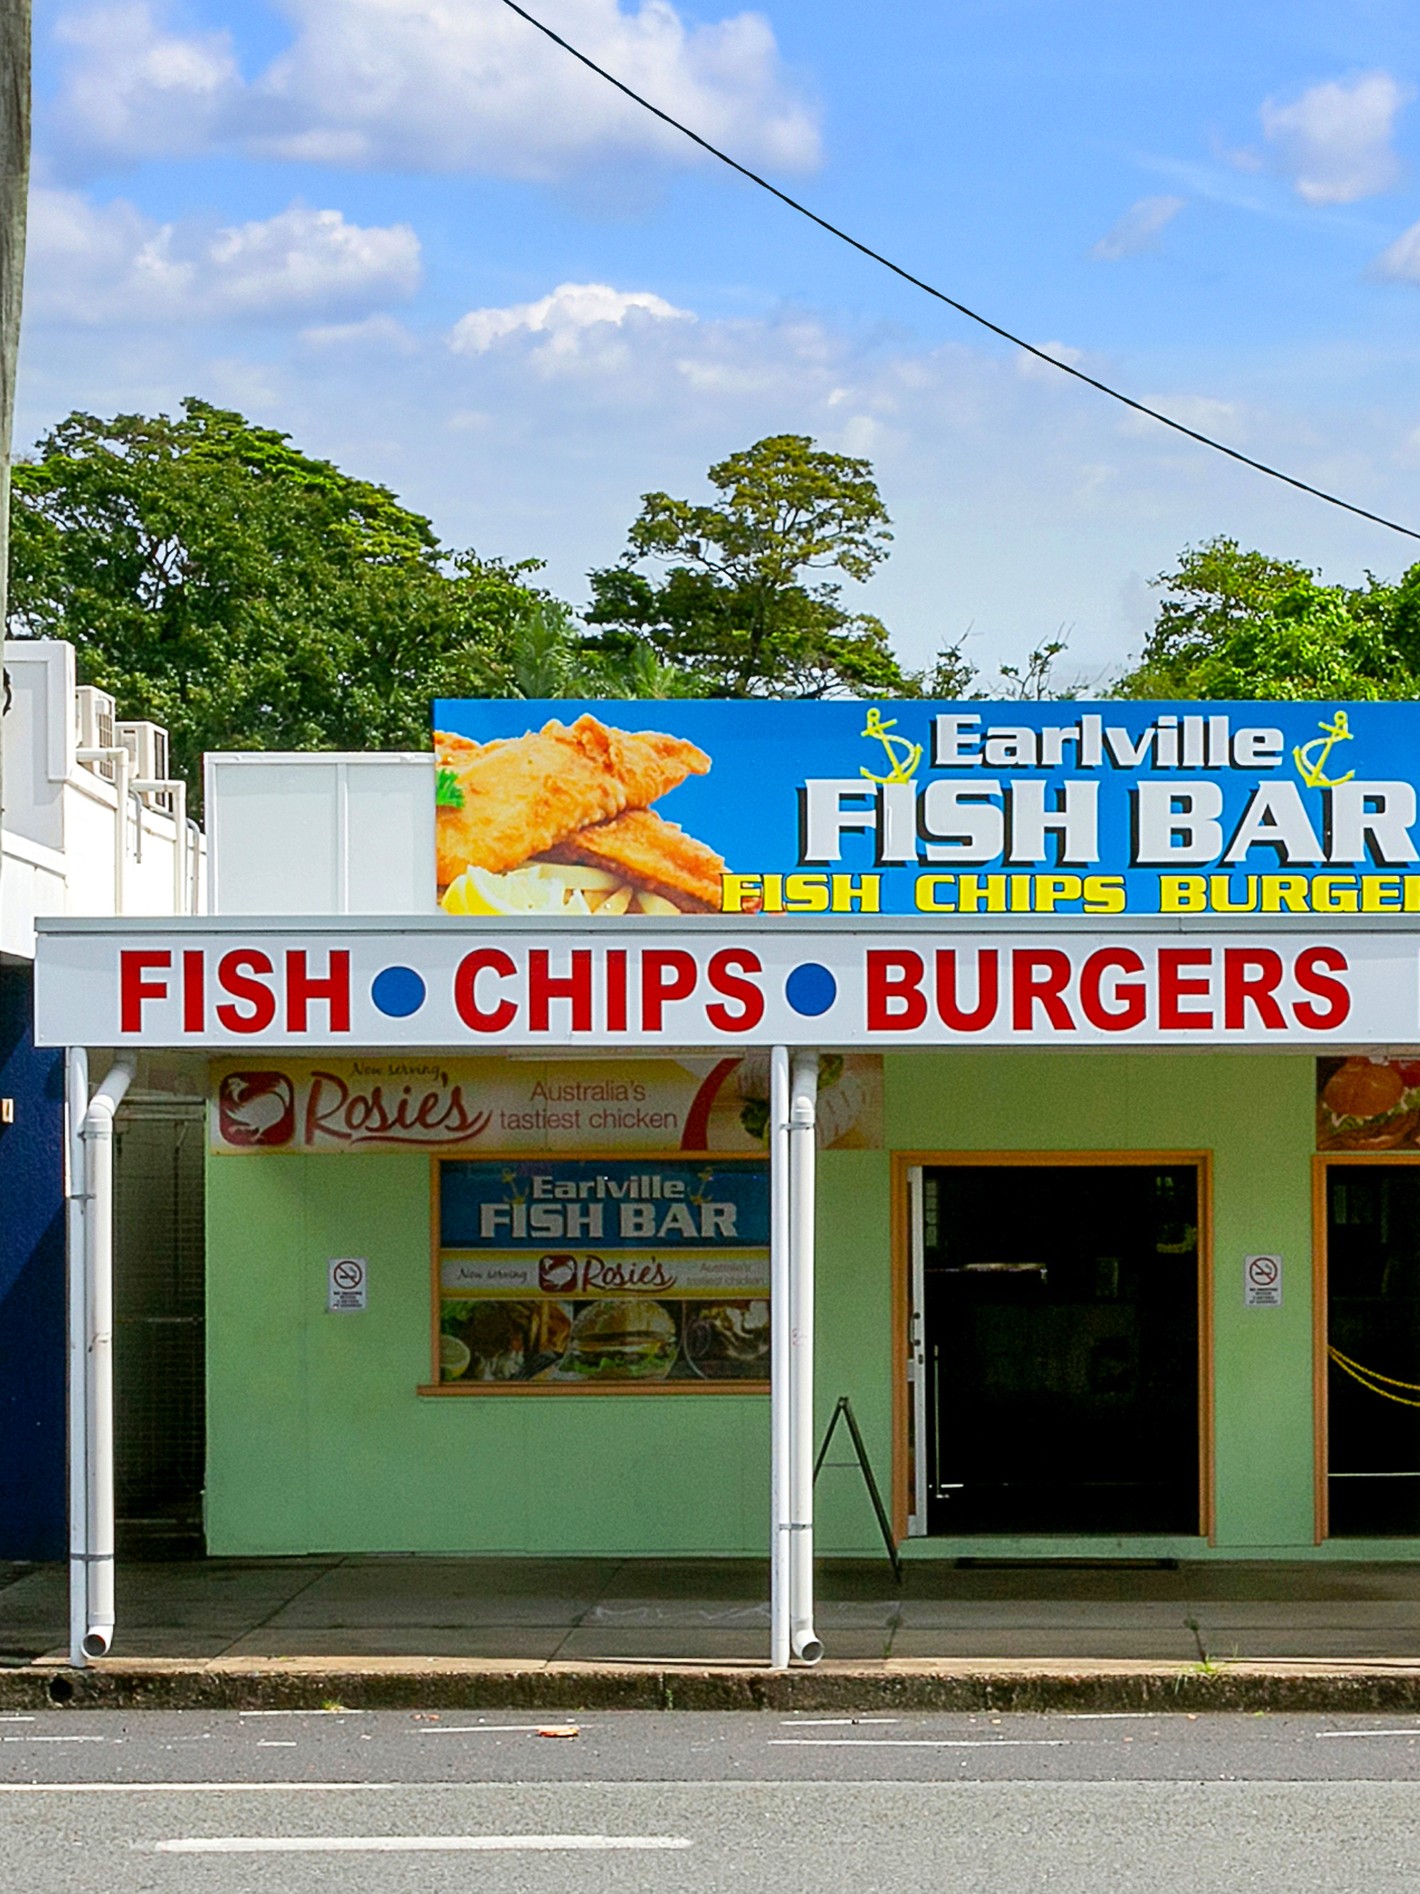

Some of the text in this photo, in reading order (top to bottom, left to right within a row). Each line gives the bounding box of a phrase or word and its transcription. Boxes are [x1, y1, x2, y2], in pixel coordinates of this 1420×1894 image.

[934, 714, 1285, 767] Earlville
[803, 779, 1420, 864] FISH BAR
[721, 874, 881, 912] FISH
[915, 874, 1126, 913] CHIPS
[120, 949, 350, 1034] FISH
[454, 948, 764, 1033] CHIPS
[866, 947, 1350, 1032] BURGERS
[352, 1062, 441, 1080] Now serving
[304, 1070, 493, 1146] Rosie's
[529, 1081, 646, 1102] Australia's
[500, 1108, 678, 1130] tastiest chicken
[532, 1175, 686, 1200] Earlville
[480, 1203, 739, 1238] FISH BAR
[581, 1254, 678, 1292] Rosie's
